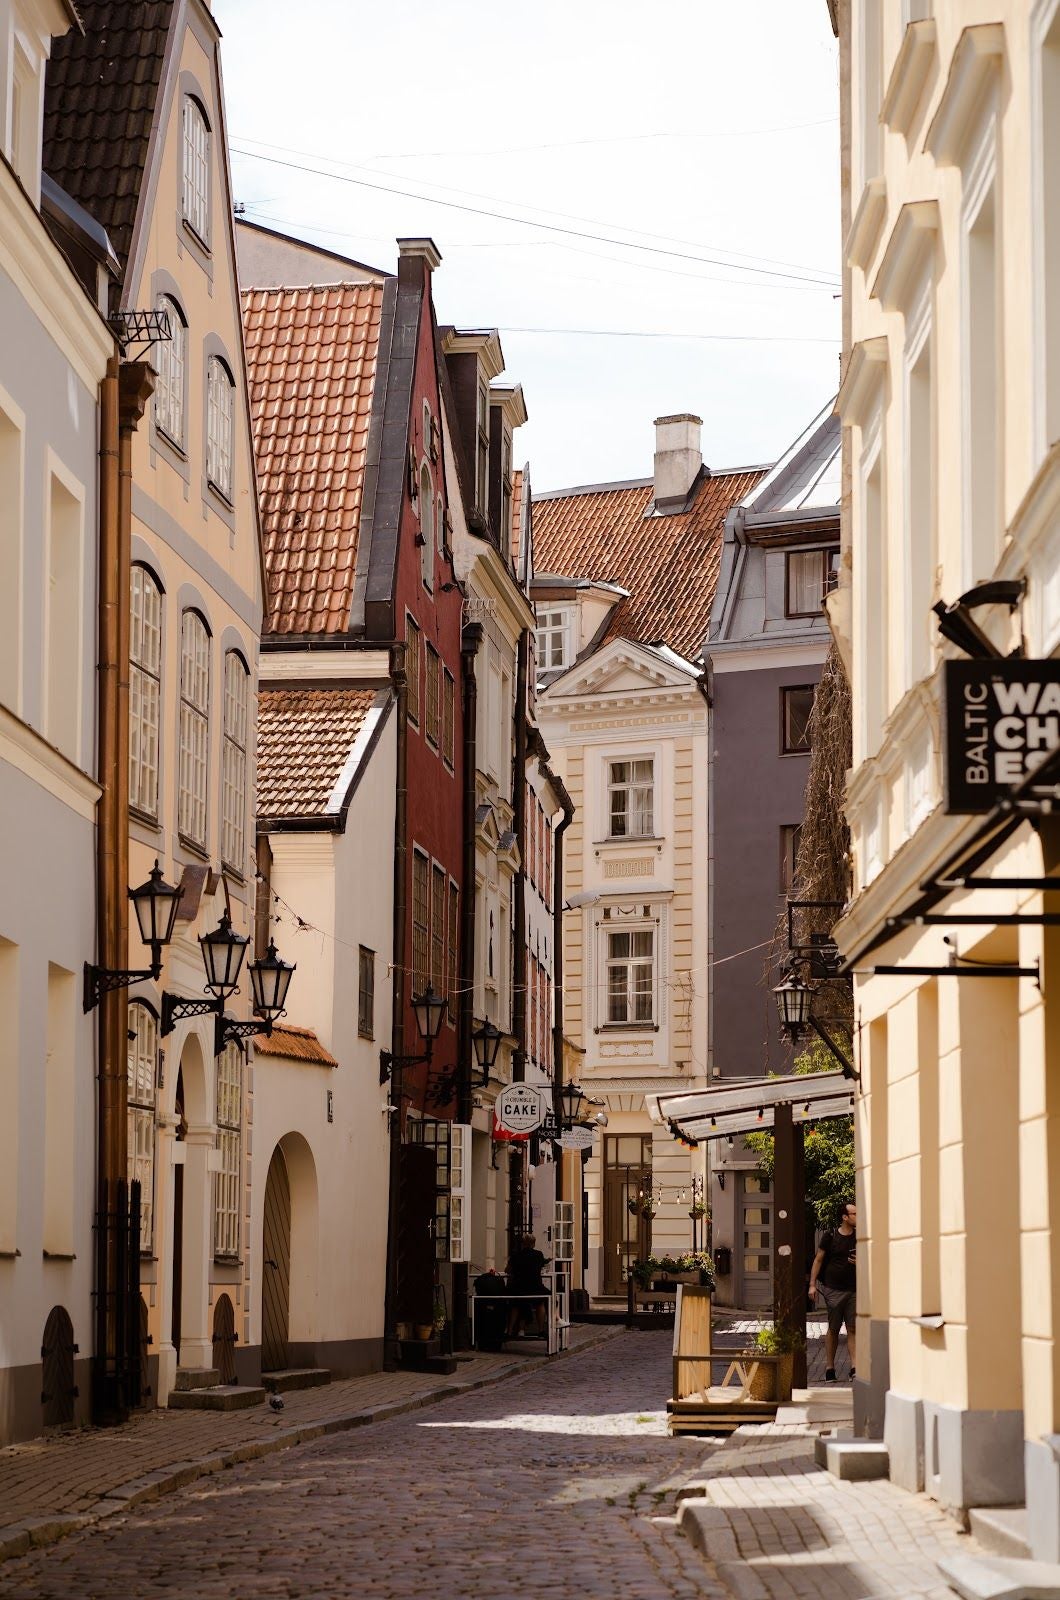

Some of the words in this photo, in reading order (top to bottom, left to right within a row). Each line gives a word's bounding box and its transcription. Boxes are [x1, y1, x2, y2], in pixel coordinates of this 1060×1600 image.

[992, 682, 1060, 716] WA
[964, 683, 989, 784] BALTIC
[993, 716, 1059, 750] CH
[504, 1105, 537, 1115] CAKE
